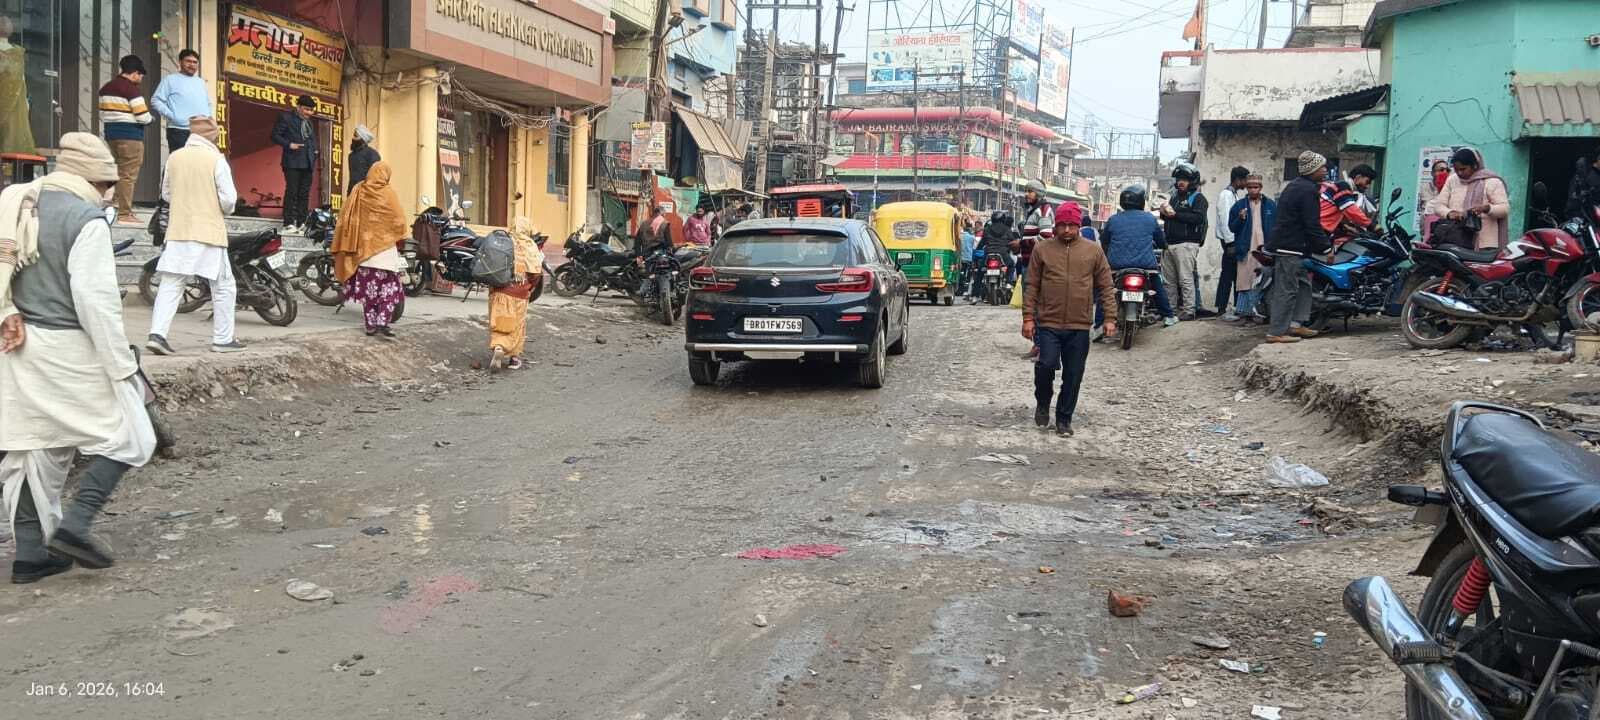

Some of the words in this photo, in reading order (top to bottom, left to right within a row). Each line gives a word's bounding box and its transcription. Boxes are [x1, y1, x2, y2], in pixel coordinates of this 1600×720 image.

[488, 7, 538, 50] ALANKAR
[539, 25, 595, 68] ORNAMENTS
[304, 38, 345, 65] वस्त्रालय
[230, 80, 287, 106] महावीर
[869, 123, 919, 133] BAJRANG
[923, 123, 969, 133] SWEETS
[750, 320, 802, 330] BR01FW7569
